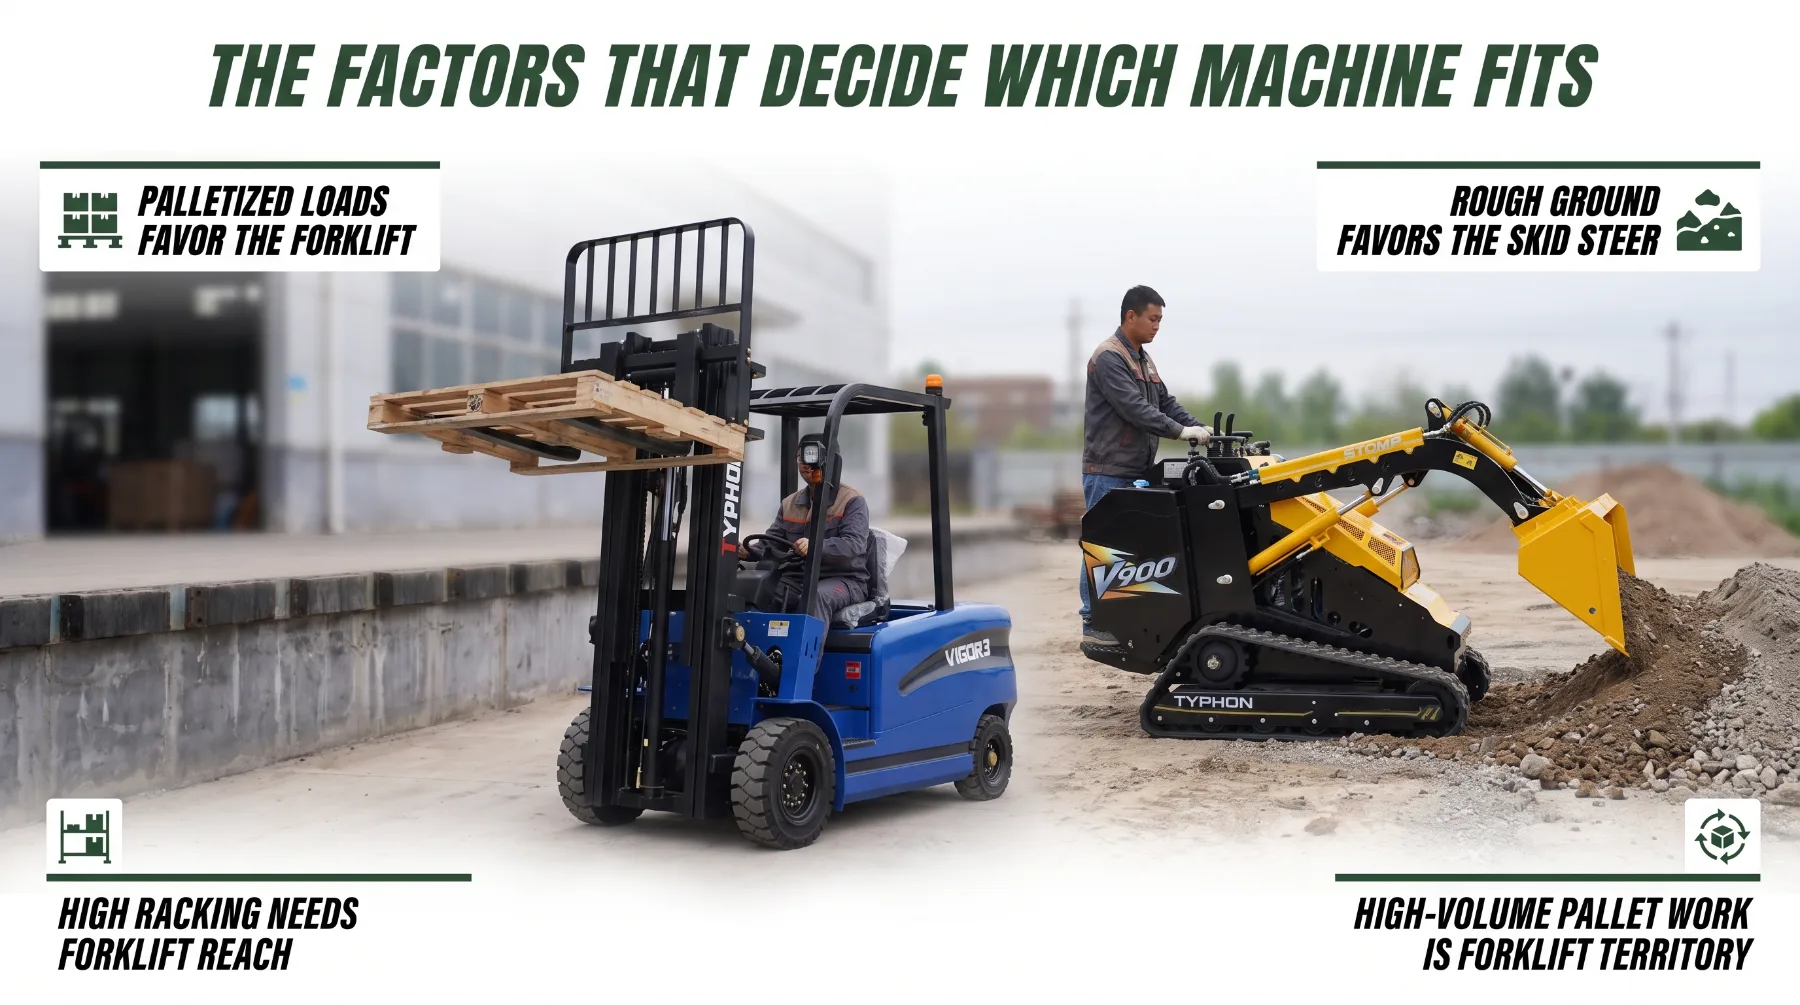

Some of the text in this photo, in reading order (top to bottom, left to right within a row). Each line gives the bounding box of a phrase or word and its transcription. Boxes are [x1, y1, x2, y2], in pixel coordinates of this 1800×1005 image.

[1343, 435, 1402, 460] STOMP
[1092, 556, 1176, 600] V900
[1173, 695, 1253, 709] TYPHON
